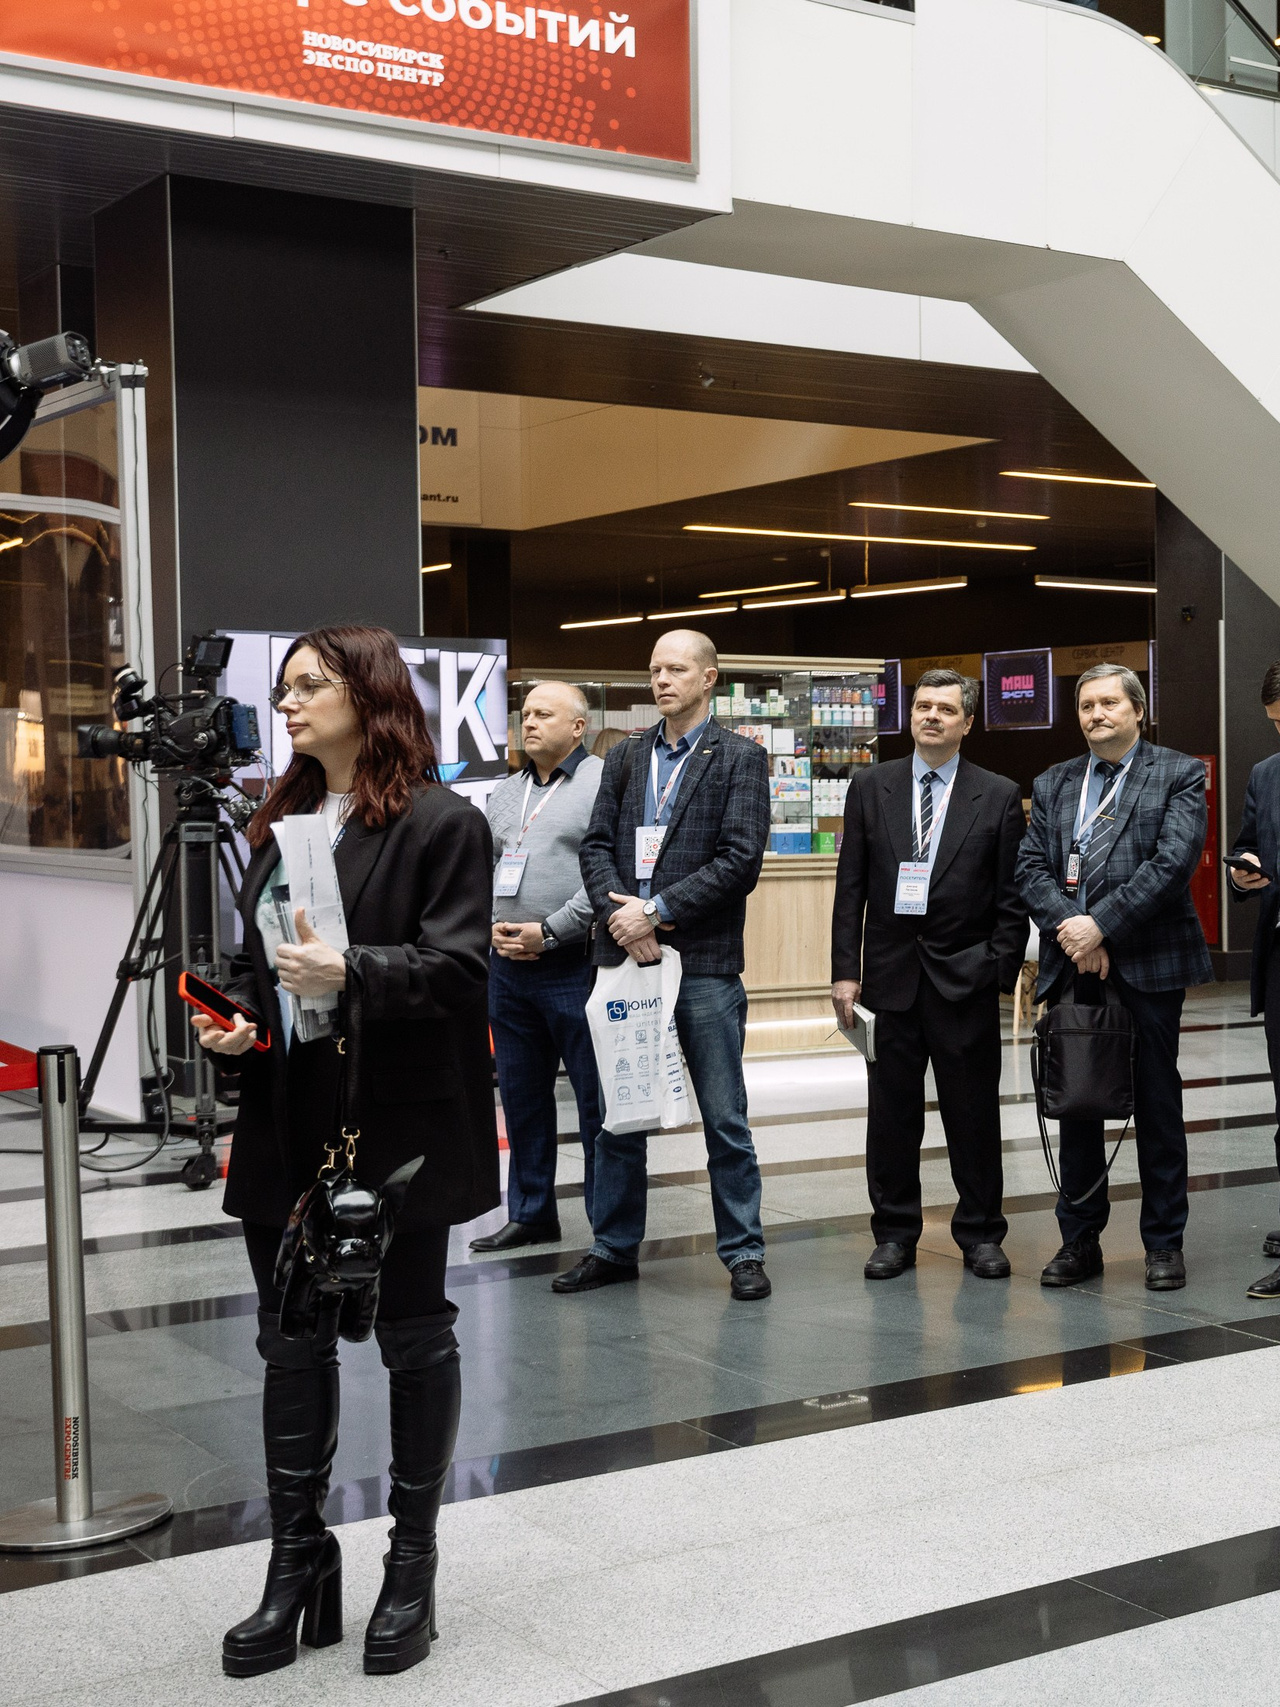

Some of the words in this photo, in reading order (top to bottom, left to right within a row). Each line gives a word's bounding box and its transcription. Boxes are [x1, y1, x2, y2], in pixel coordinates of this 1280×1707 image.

[302, 30, 445, 70] НОВОСИБИРСК
[302, 50, 375, 76] ЭКСПО
[376, 62, 445, 87] ЦЕНТР
[1001, 674, 1035, 691] МАШ
[64, 1417, 72, 1442] EXPO
[72, 1416, 80, 1480] NOVOSIBIRSK
